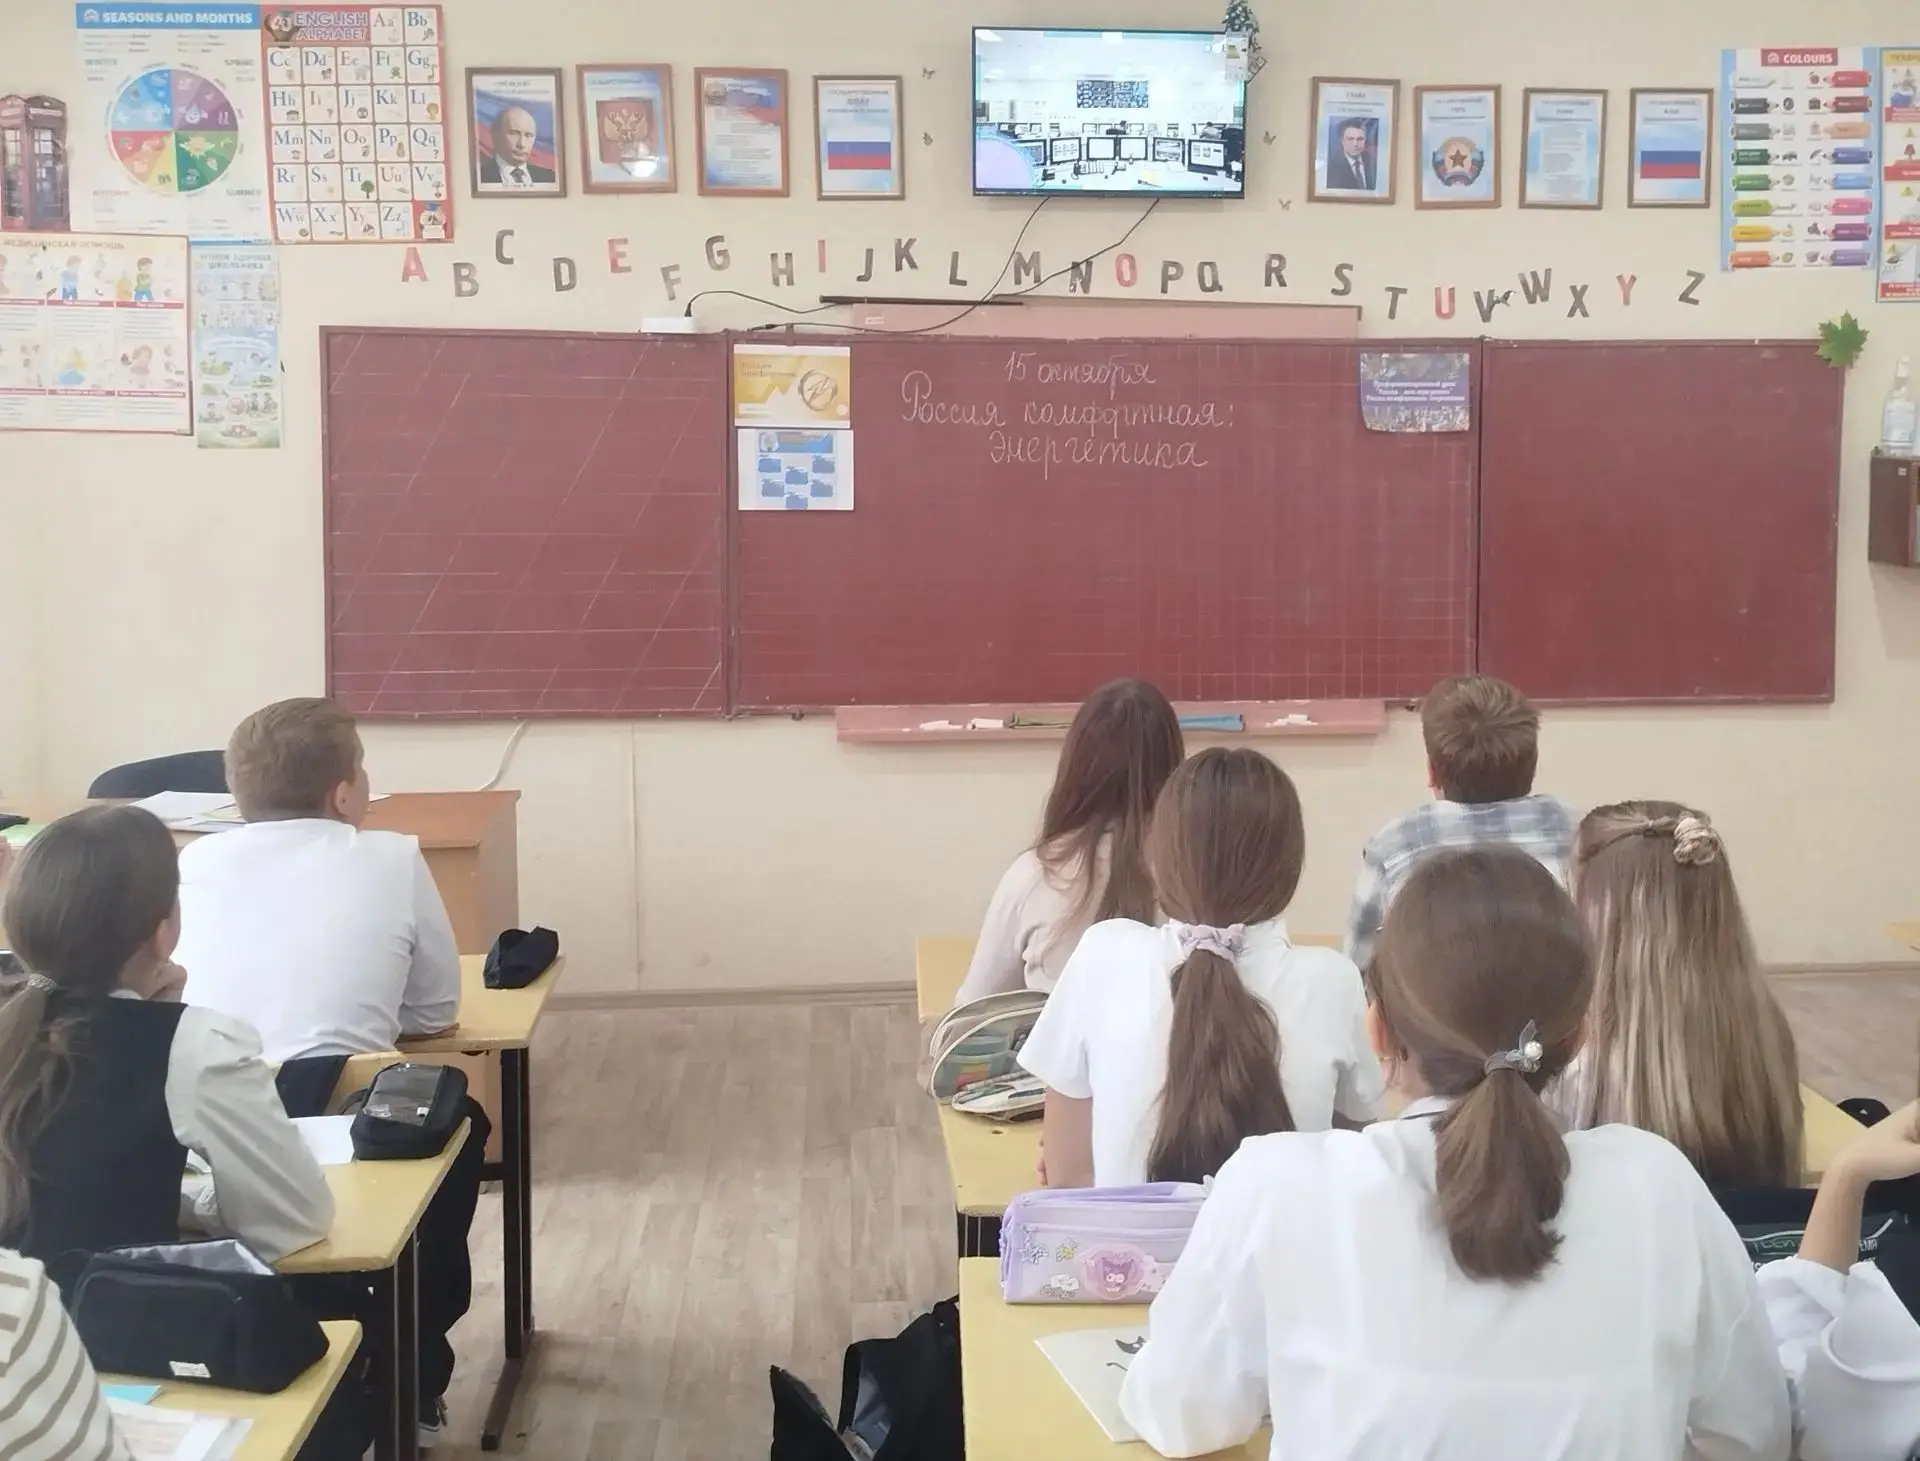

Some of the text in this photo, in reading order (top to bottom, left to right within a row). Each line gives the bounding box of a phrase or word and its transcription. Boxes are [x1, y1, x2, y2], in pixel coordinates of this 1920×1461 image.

[102, 12, 253, 24] SEASONS AND MONTHS
[295, 11, 369, 27] ENGLISH
[373, 11, 428, 28] Aa Bb
[295, 27, 368, 41] ALPHABET
[270, 50, 429, 69] Cc Dd Ee Ff Gg
[1783, 53, 1833, 64] COLOURS
[272, 91, 296, 107] Hh
[310, 91, 321, 106] Ii
[344, 90, 355, 108] Jj
[376, 89, 398, 105] Kk
[274, 128, 436, 147] Mm Nn Oo Pp Qq
[276, 166, 434, 183] Rr Ss Tt Uu Vv
[277, 206, 401, 225] Ww Xx Yy Zz
[401, 229, 1706, 323] A B C D E F G H I J K L M N O P Q R S T U V W X Y Z
[1004, 351, 1156, 400] 15 октября
[901, 369, 1007, 427] Россия
[989, 430, 1209, 481] Энергетика
